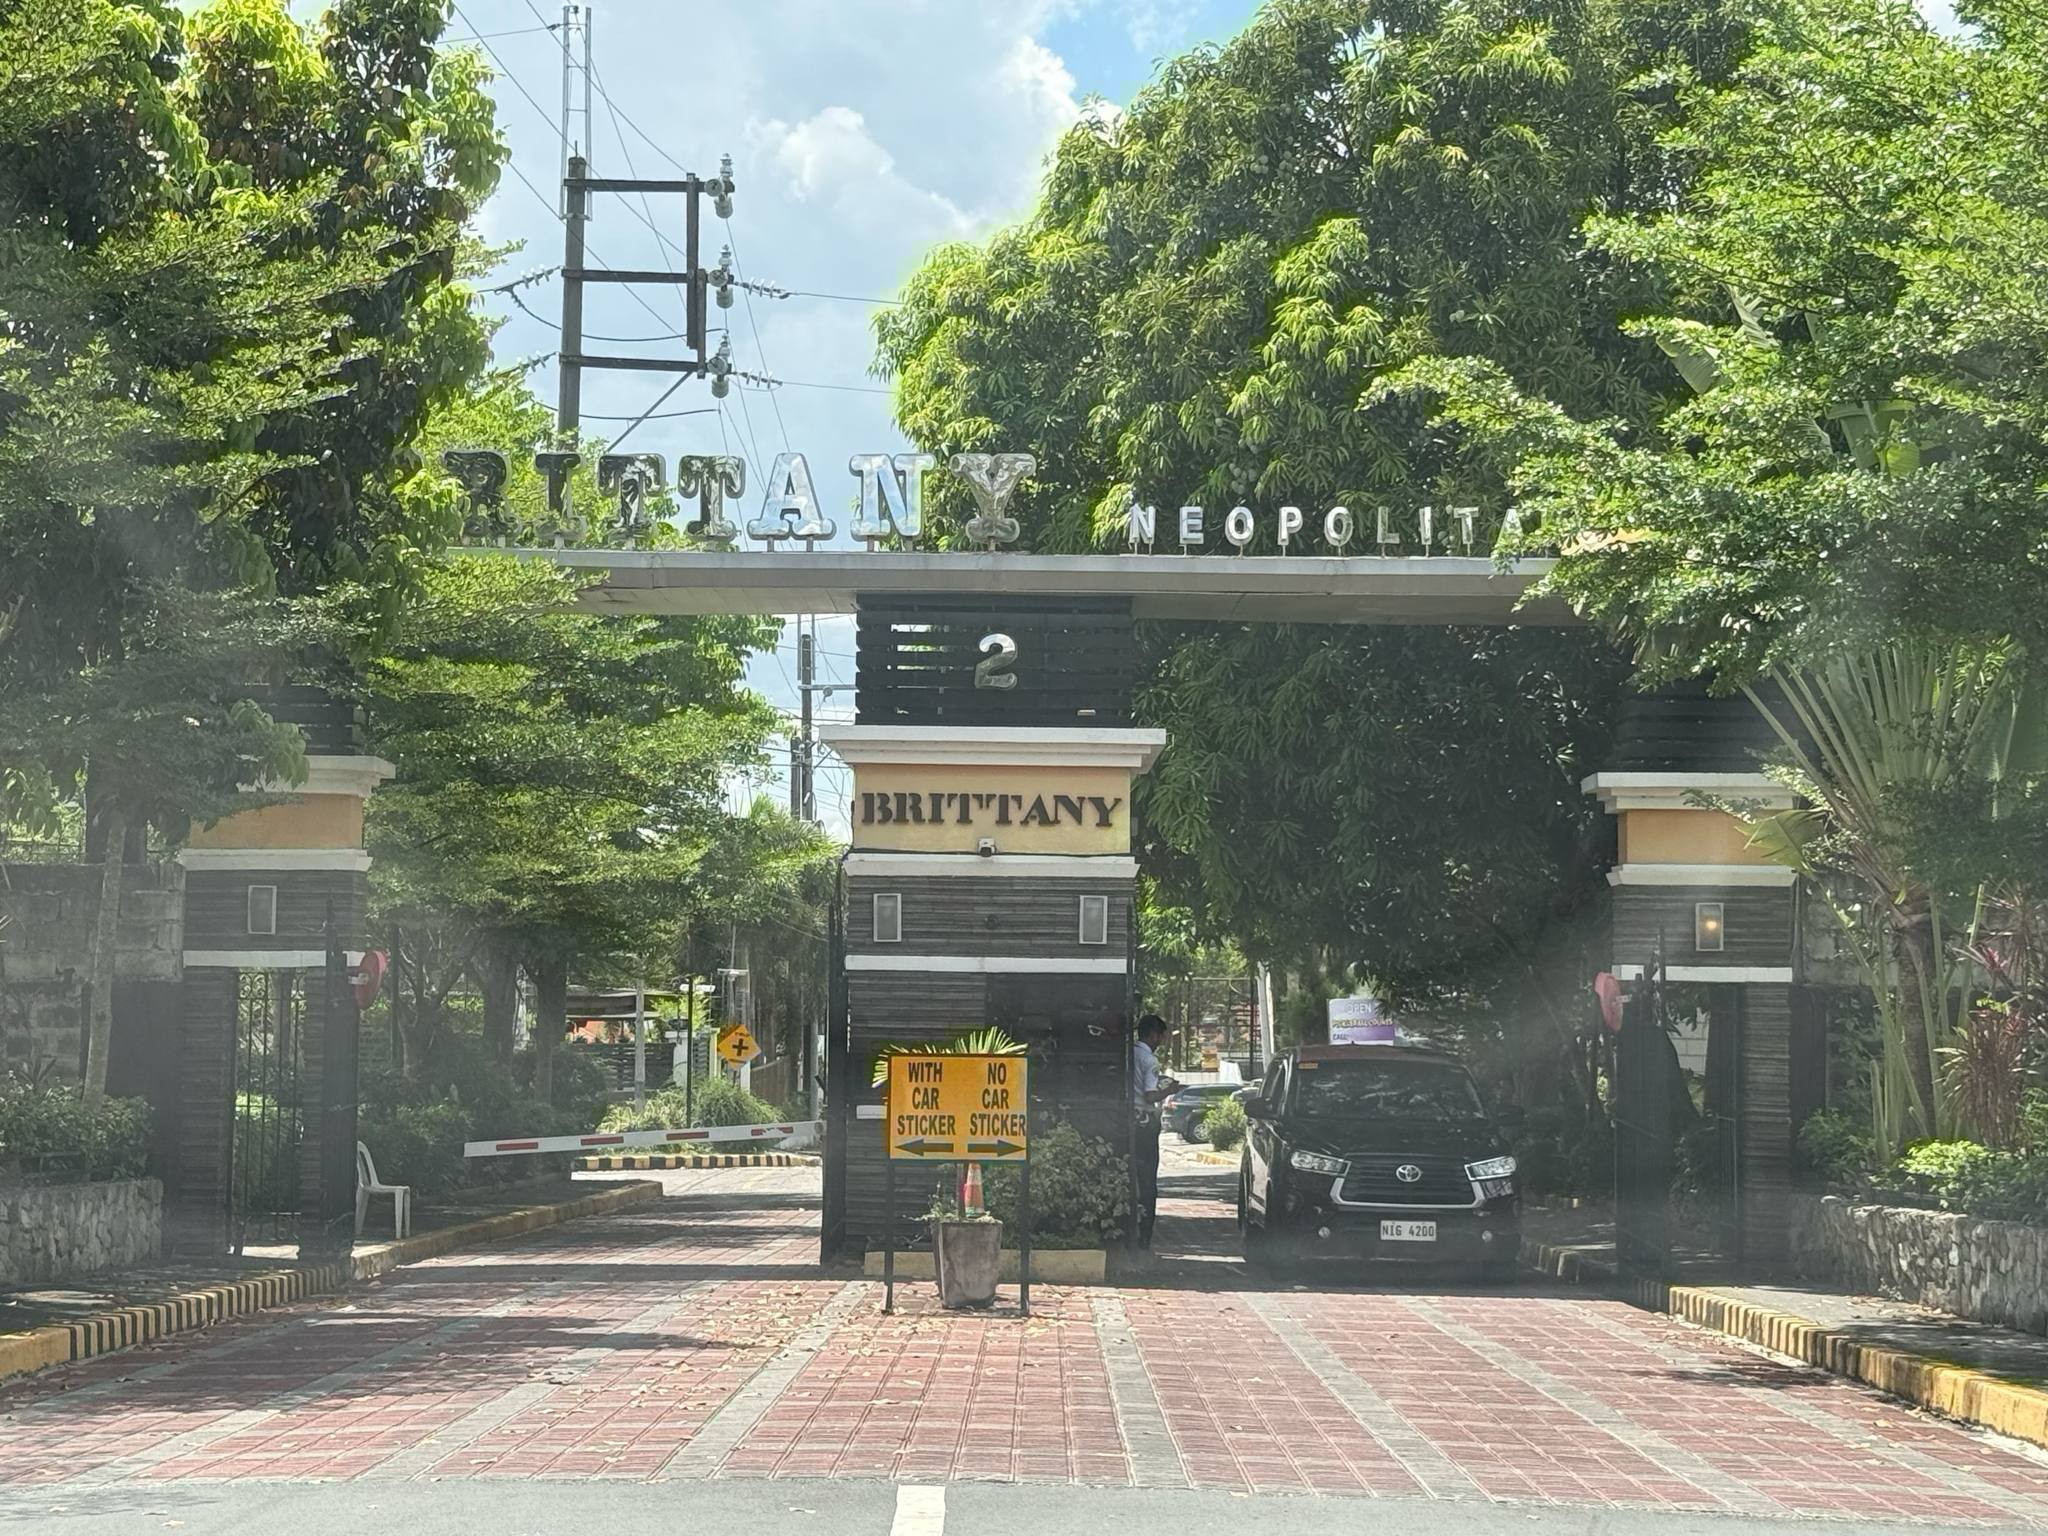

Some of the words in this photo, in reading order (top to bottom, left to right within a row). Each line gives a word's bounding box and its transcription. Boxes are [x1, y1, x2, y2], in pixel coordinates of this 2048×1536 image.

[1127, 504, 1530, 546] NEOPOLITA
[974, 633, 1017, 689] 2
[861, 792, 1122, 827] BRITTANY
[908, 1062, 943, 1083] WITH
[987, 1062, 1007, 1085] NO
[911, 1087, 940, 1110] CAR
[981, 1088, 1009, 1109] CAR
[897, 1114, 956, 1136] STICKER
[969, 1113, 1026, 1136] STICKER
[1408, 1225, 1434, 1236] 4200
